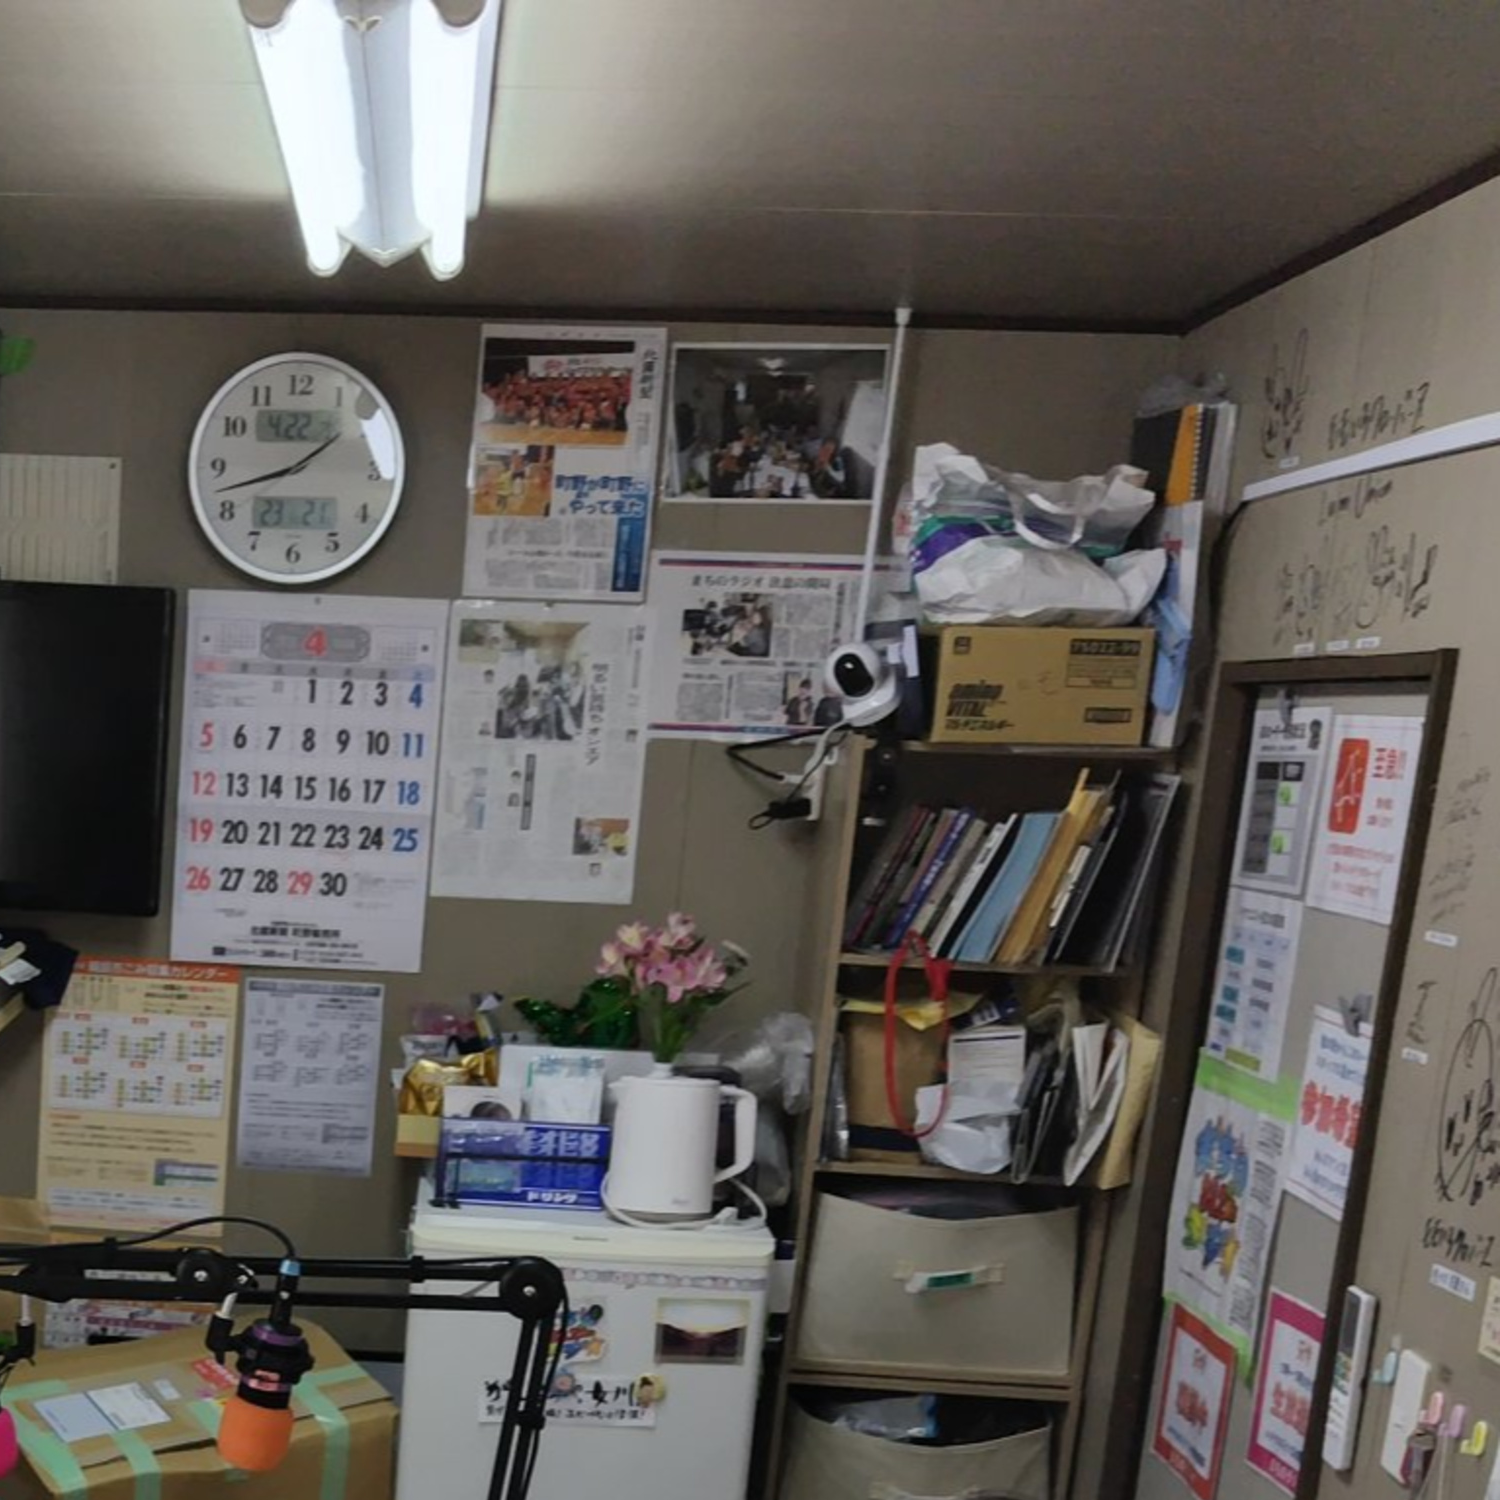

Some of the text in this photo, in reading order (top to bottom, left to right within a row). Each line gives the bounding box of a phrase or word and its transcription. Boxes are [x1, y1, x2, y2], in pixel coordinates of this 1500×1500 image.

[250, 385, 272, 408] 11
[288, 374, 315, 397] 12
[222, 415, 247, 438] 10
[209, 457, 227, 481] 9
[218, 500, 236, 522] 8
[247, 531, 262, 552] 7
[325, 532, 341, 553] 5
[285, 543, 302, 564] 6
[304, 627, 329, 658] 4
[308, 679, 423, 708] 1 2 3 4
[200, 722, 424, 758] 5 6 7 8 9 10 11
[191, 771, 420, 805] 12 13 14 15 16 17 18
[188, 818, 419, 852] 19 20 21 22 23 24 25
[185, 866, 347, 897] 26 27 28 29 30
[526, 1190, 579, 1204] ドリンク
